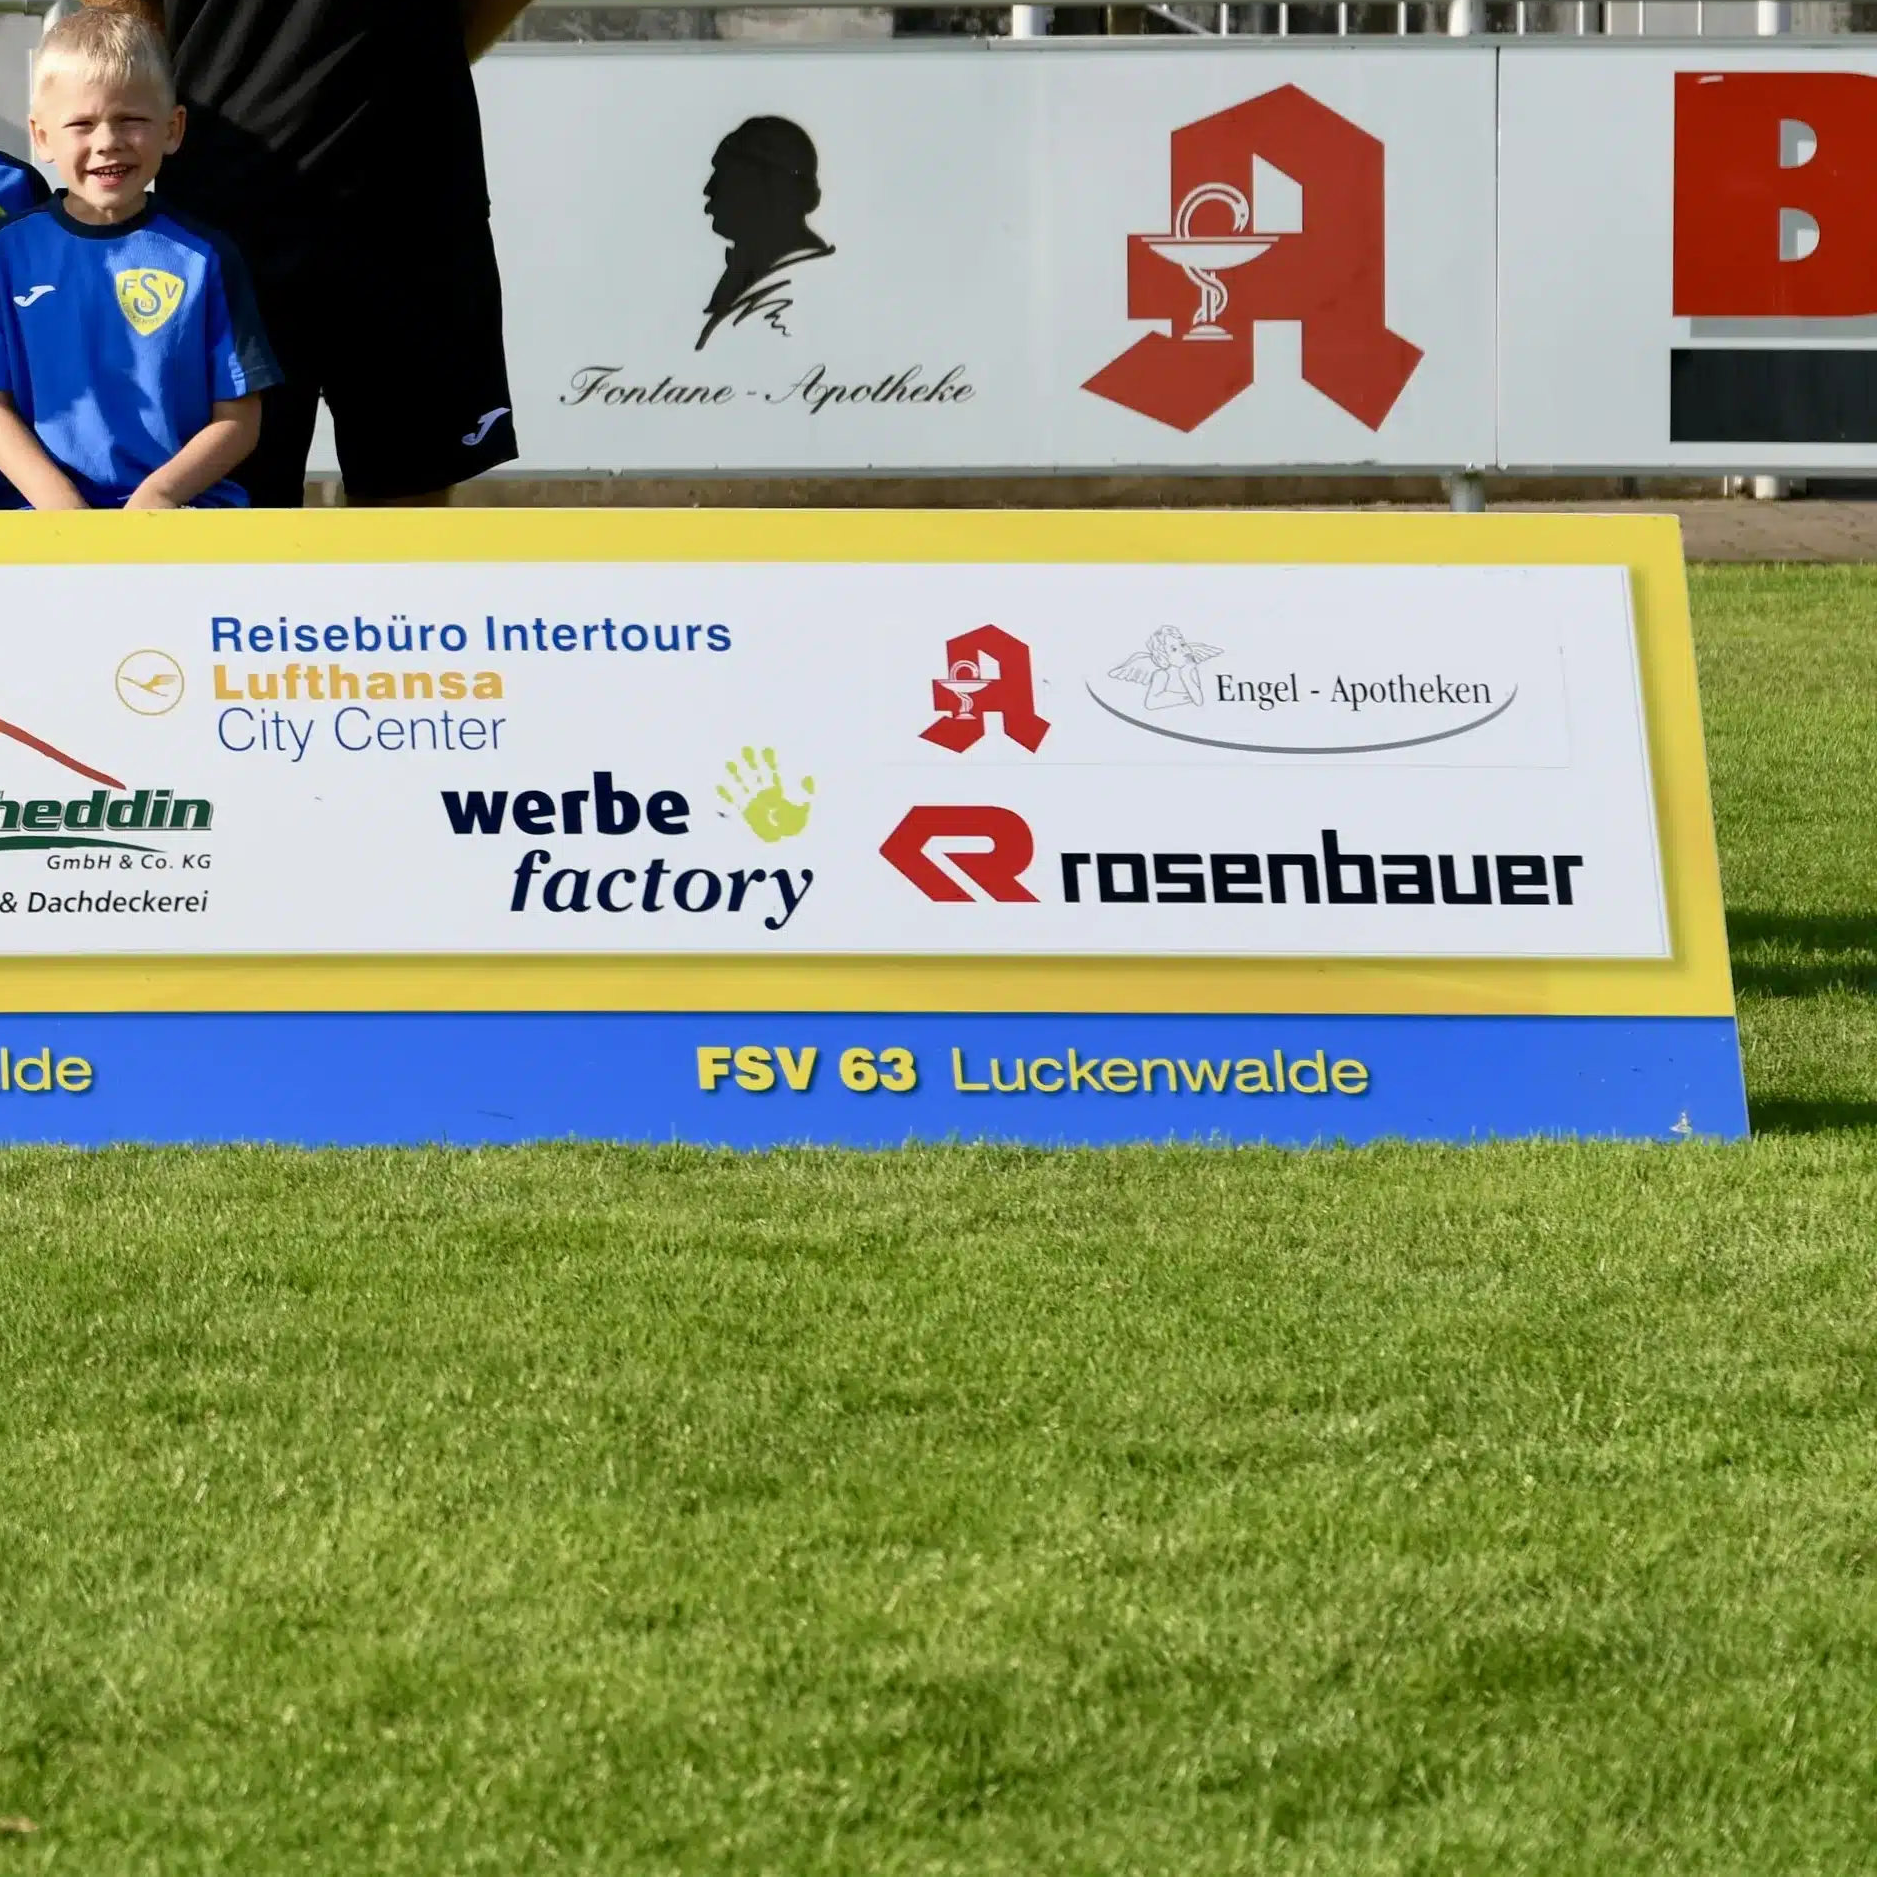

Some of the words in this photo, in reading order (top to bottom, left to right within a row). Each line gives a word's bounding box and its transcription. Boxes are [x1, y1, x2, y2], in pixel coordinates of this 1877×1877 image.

[122, 273, 178, 317] FSV
[560, 366, 732, 405] Fontane
[765, 366, 972, 414] Apotheke
[212, 615, 467, 652] Reisebüro
[486, 616, 731, 651] Intertours
[213, 663, 503, 700] Lufthansa
[1216, 673, 1299, 710] Engel
[1331, 674, 1491, 711] Apotheken
[218, 708, 314, 762] City
[335, 707, 506, 752] Center
[441, 771, 690, 835] werbe
[47, 854, 111, 869] GmbH
[119, 855, 132, 869] &
[141, 853, 174, 870] Co.
[183, 854, 211, 869] KG
[1061, 829, 1583, 905] rosenbauer
[0, 892, 17, 913] &
[28, 890, 208, 913] Dachdeckerei
[511, 850, 813, 930] factory
[697, 1046, 819, 1094] FSV
[839, 1047, 919, 1094] 63
[952, 1047, 1371, 1096] Luckenwalde
